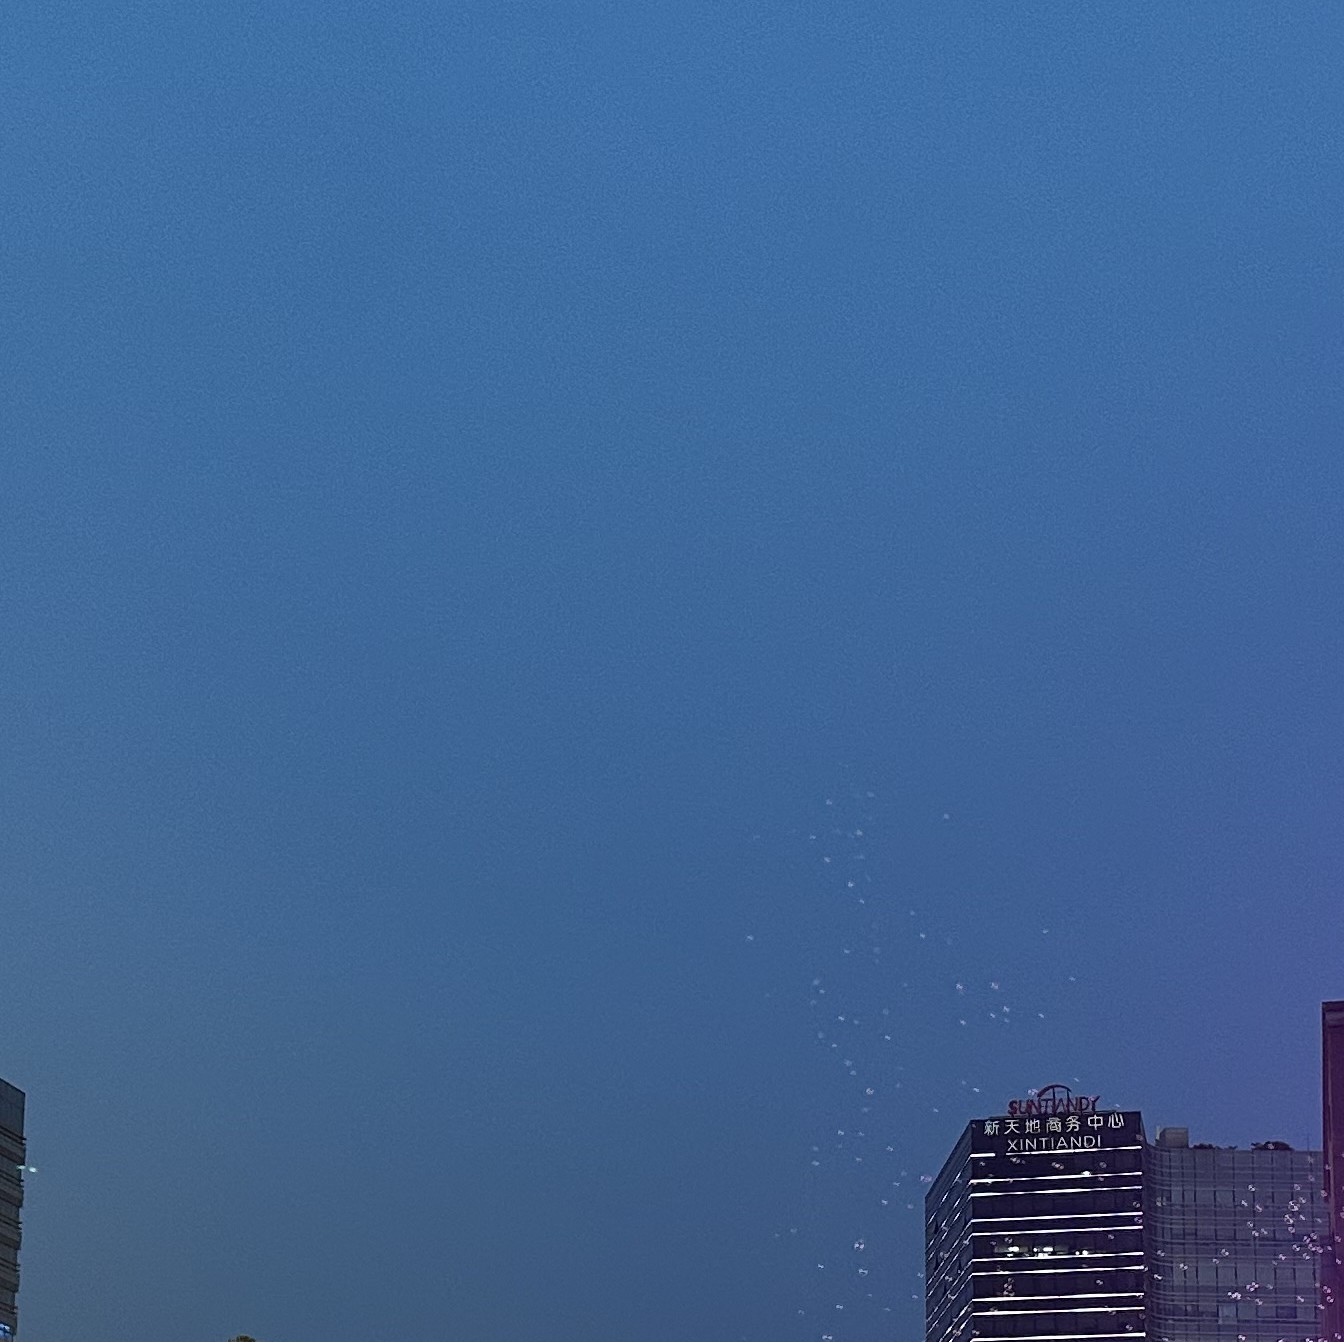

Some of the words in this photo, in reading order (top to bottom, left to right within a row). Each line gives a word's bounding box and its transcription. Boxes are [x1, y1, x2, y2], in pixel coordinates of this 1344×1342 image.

[983, 1112, 1125, 1136] 新天地商务中心
[1007, 1134, 1102, 1151] XINTIANDI
